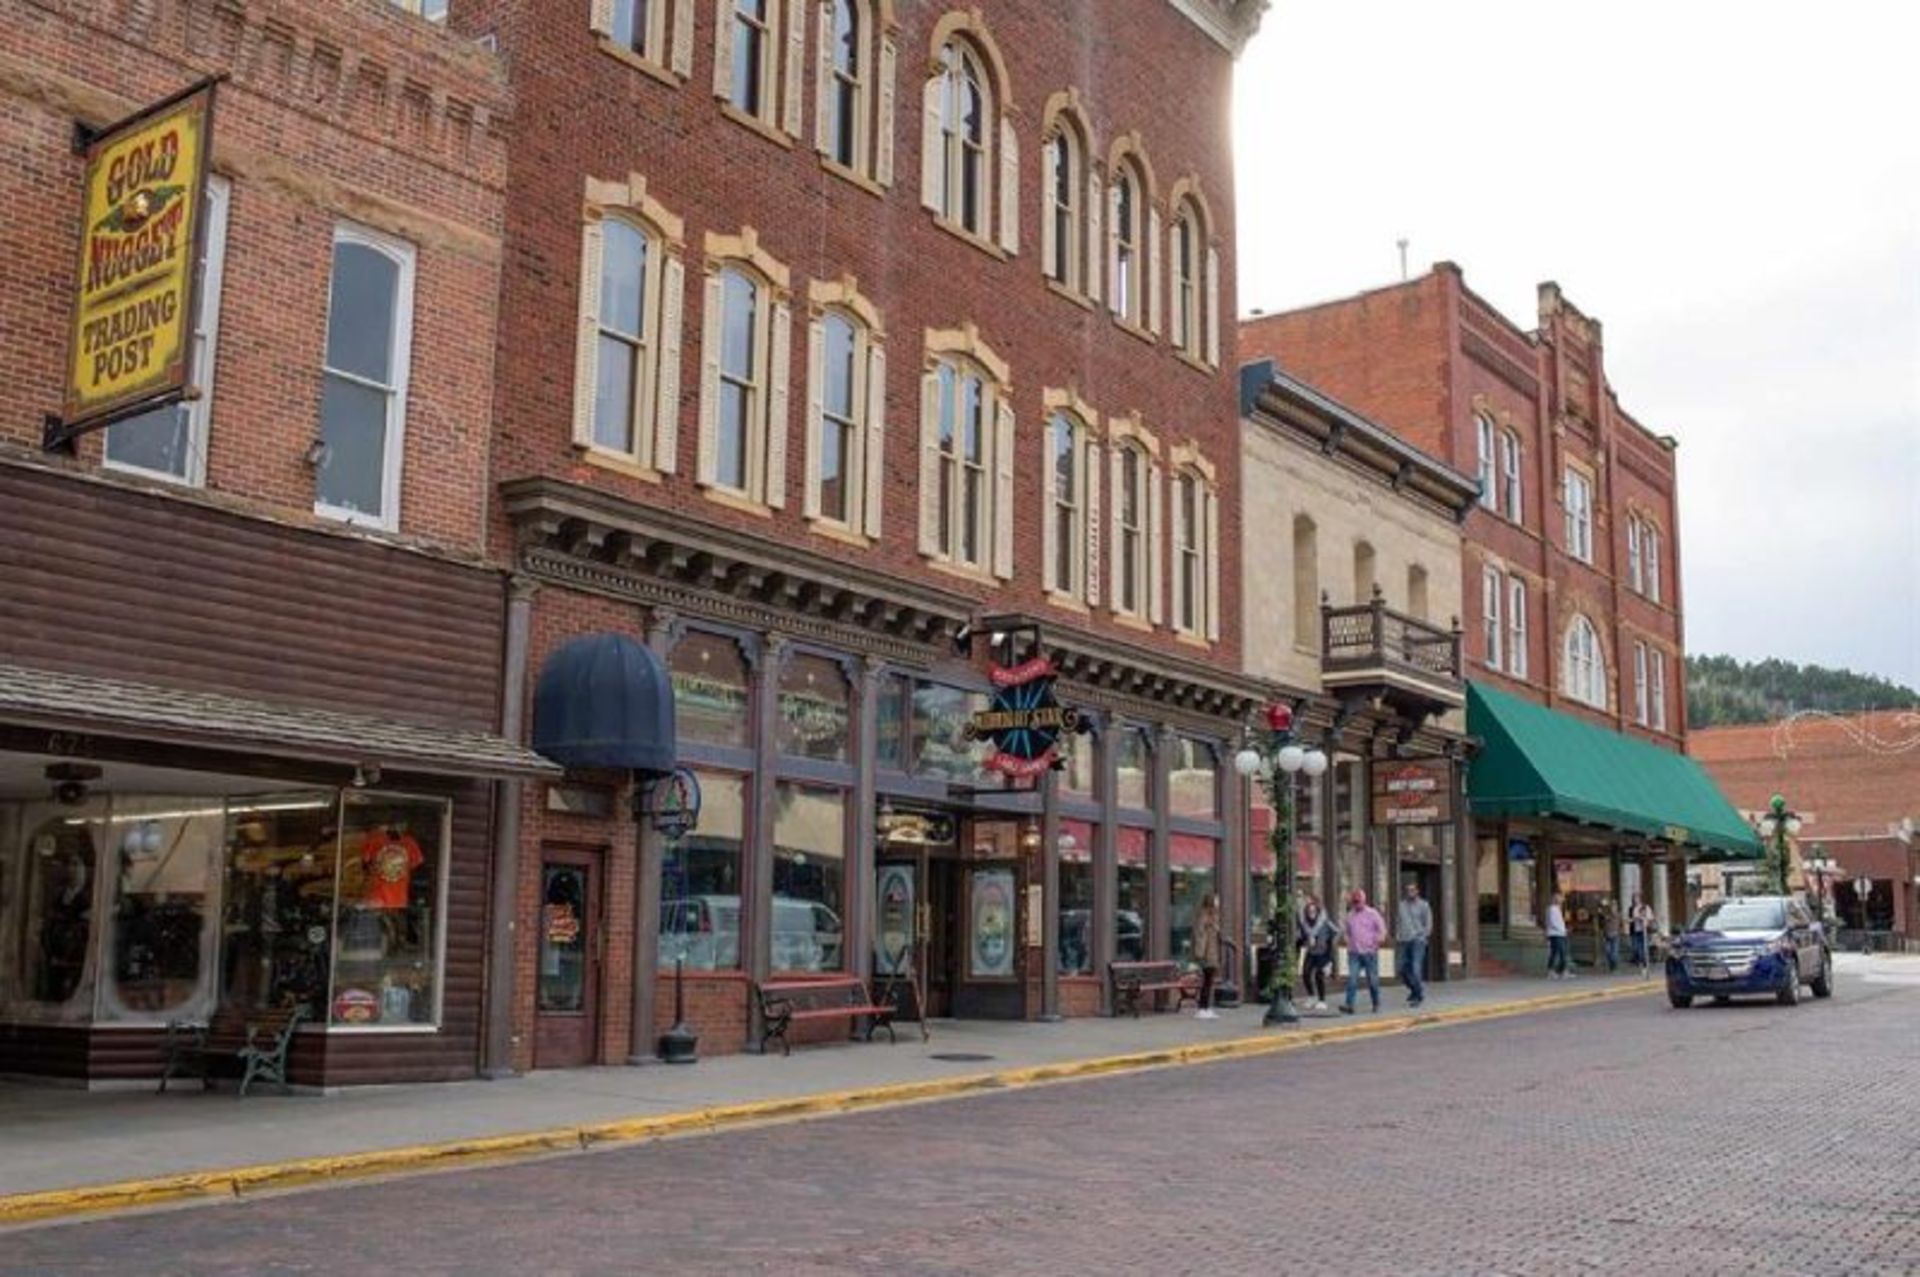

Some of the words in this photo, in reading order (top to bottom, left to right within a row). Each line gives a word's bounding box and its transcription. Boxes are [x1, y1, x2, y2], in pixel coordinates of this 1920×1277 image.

[107, 130, 178, 206] GOLD
[86, 198, 183, 293] NUGGET
[84, 290, 176, 354] TRADING
[92, 335, 154, 386] POST
